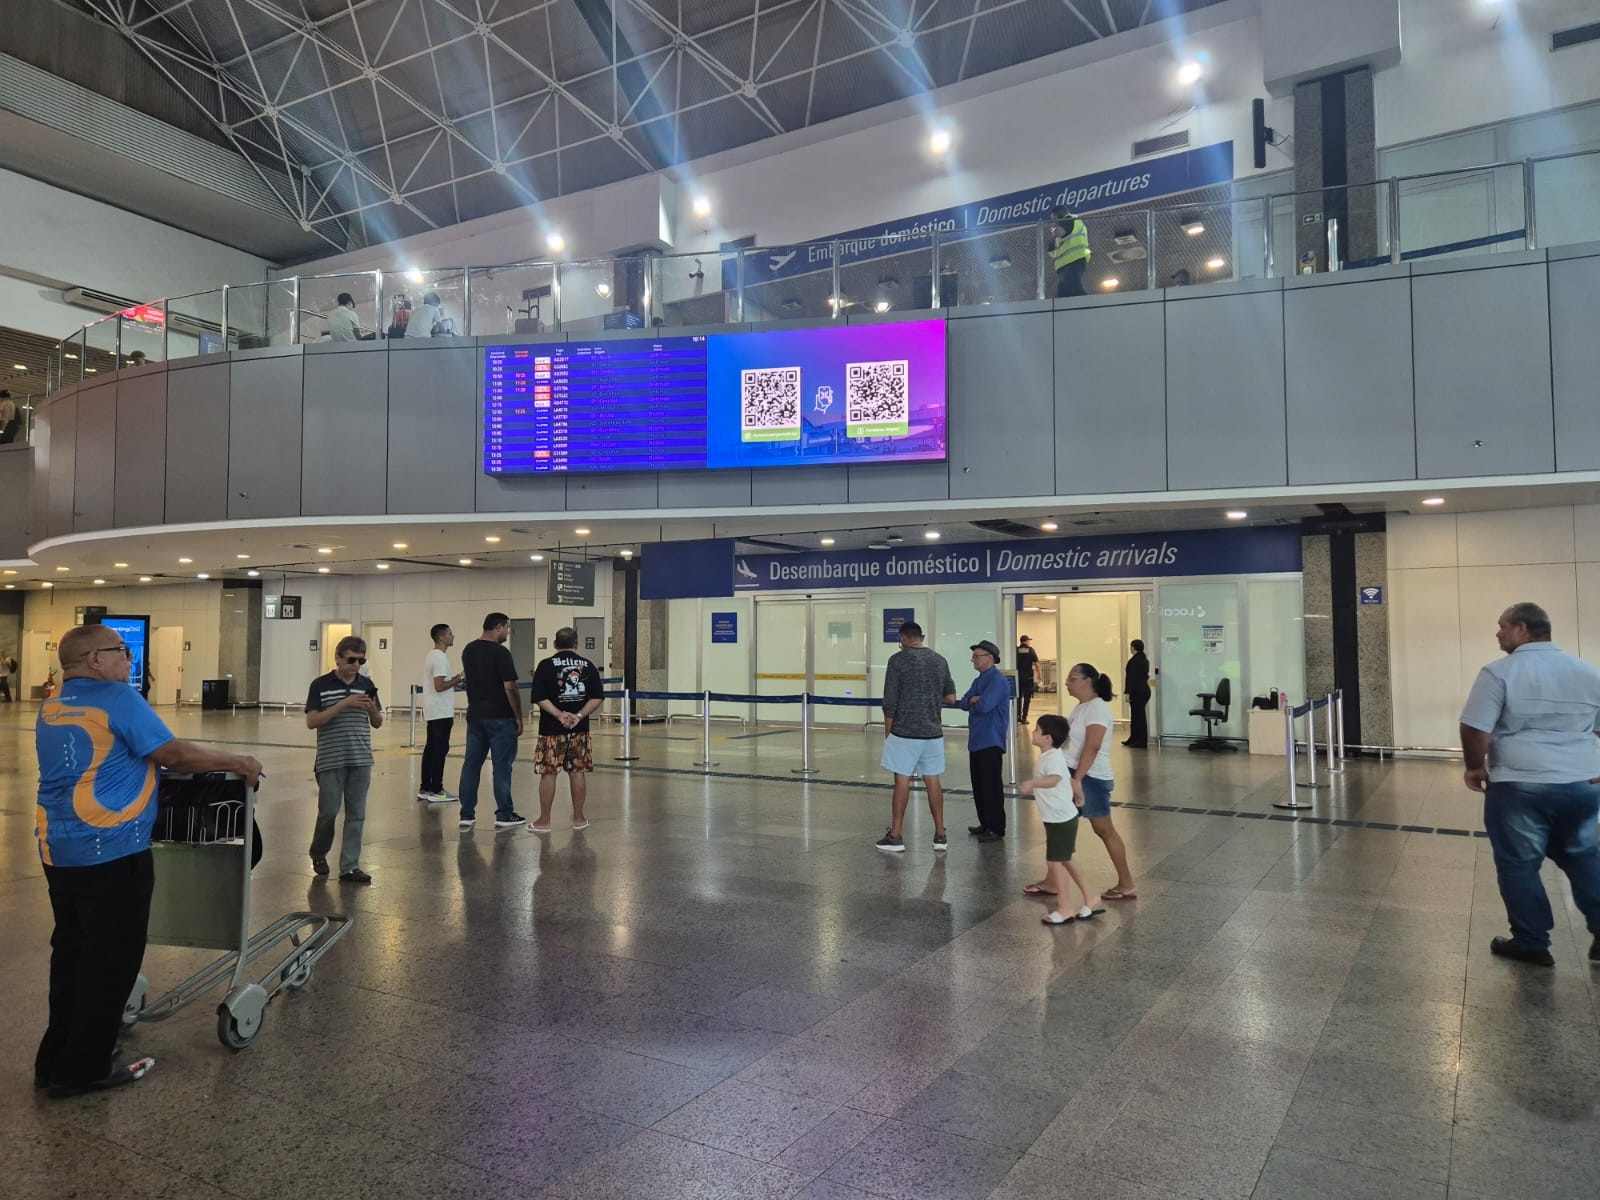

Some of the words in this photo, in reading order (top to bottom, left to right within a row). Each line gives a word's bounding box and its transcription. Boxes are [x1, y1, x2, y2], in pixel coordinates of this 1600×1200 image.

[976, 193, 1052, 226] Domestic
[1055, 173, 1151, 208] departures
[808, 239, 876, 263] Embarque
[880, 218, 956, 246] doméstico
[769, 559, 880, 582] Desembarque
[886, 553, 980, 577] doméstico
[996, 546, 1091, 572] Domestic
[1096, 541, 1178, 567] arrivals
[552, 657, 589, 667] Believe
